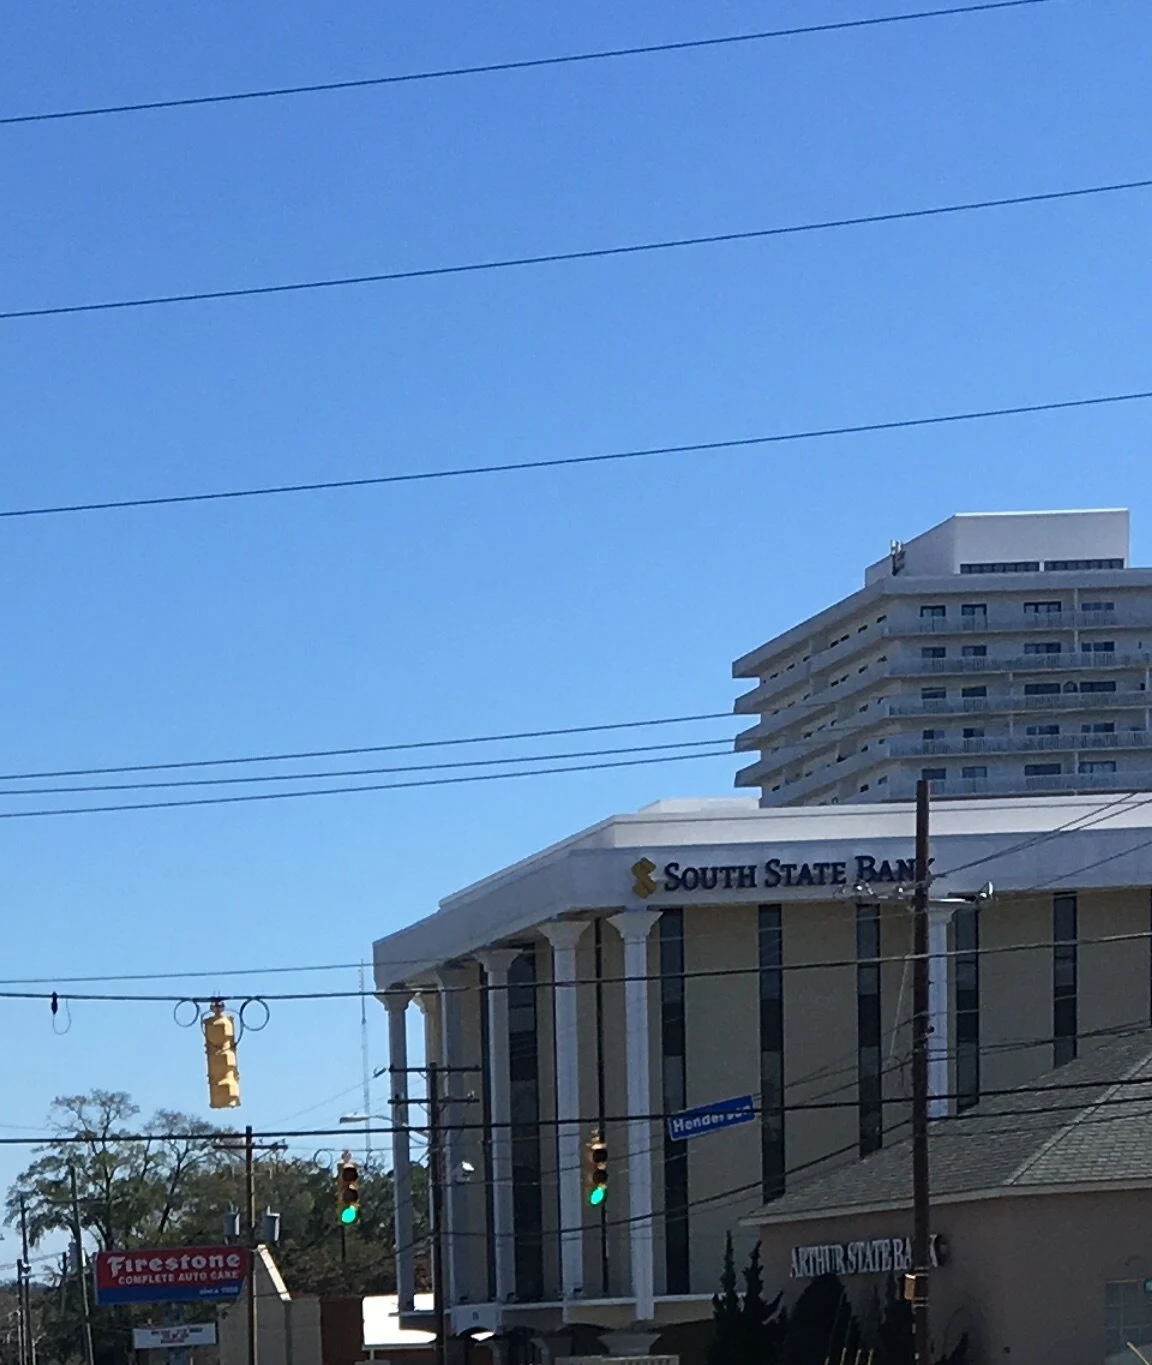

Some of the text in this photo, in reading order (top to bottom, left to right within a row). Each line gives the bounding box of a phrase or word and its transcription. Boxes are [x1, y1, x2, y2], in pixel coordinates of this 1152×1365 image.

[663, 855, 935, 892] SOUTH STATE BAN
[106, 1253, 241, 1278] Firestone
[789, 1243, 846, 1279] ARTHUR
[847, 1239, 892, 1274] STATE
[118, 1270, 239, 1285] COMPLETE AUTO CARE
